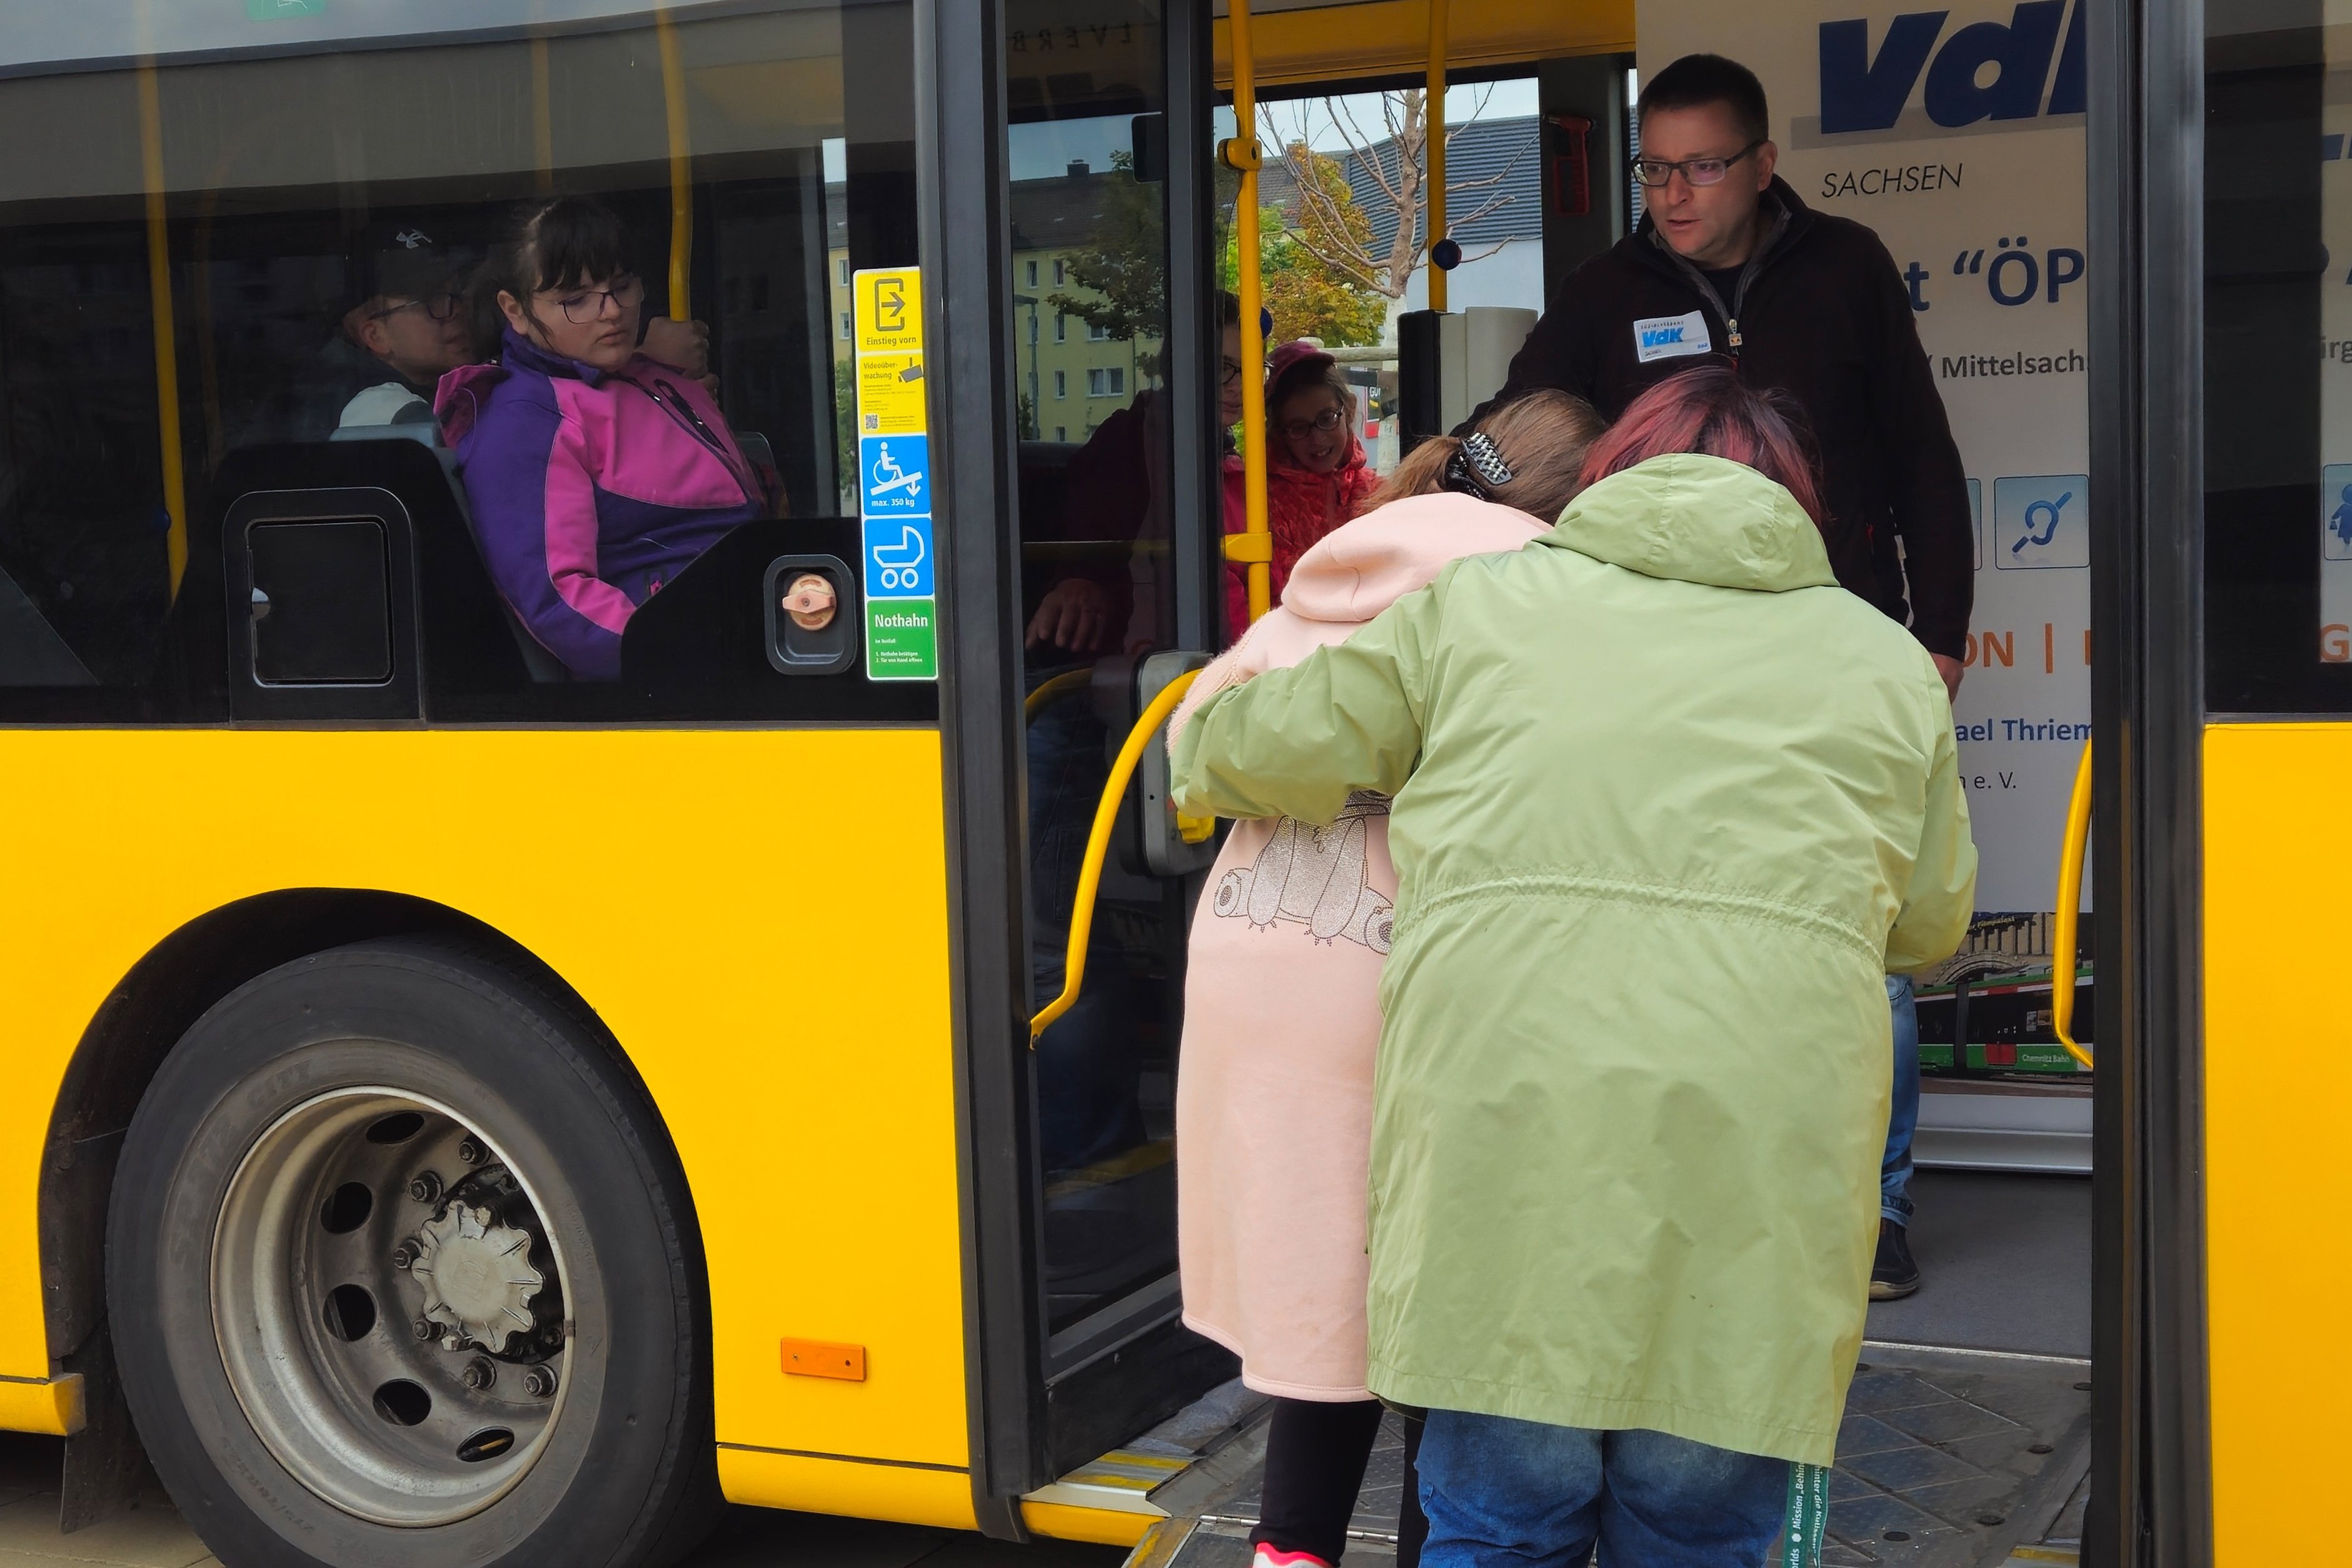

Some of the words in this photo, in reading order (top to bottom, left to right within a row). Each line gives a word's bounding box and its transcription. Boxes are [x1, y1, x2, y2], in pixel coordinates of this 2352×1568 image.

[1821, 163, 1963, 198] SACHSEN
[866, 336, 897, 346] Einstieg
[1642, 327, 1684, 348] VdK
[1942, 348, 2085, 378] Mittelsach
[863, 372, 892, 380] wachung
[891, 498, 904, 506] 350
[905, 498, 915, 507] kg
[875, 613, 928, 628] Nothahn
[1974, 775, 1991, 789] e.
[1999, 771, 2016, 789] V.
[2053, 1055, 2070, 1063] Bahn
[1795, 1462, 1806, 1495] „Behin
[1814, 1495, 1823, 1509] die
[1792, 1495, 1804, 1530] Mission
